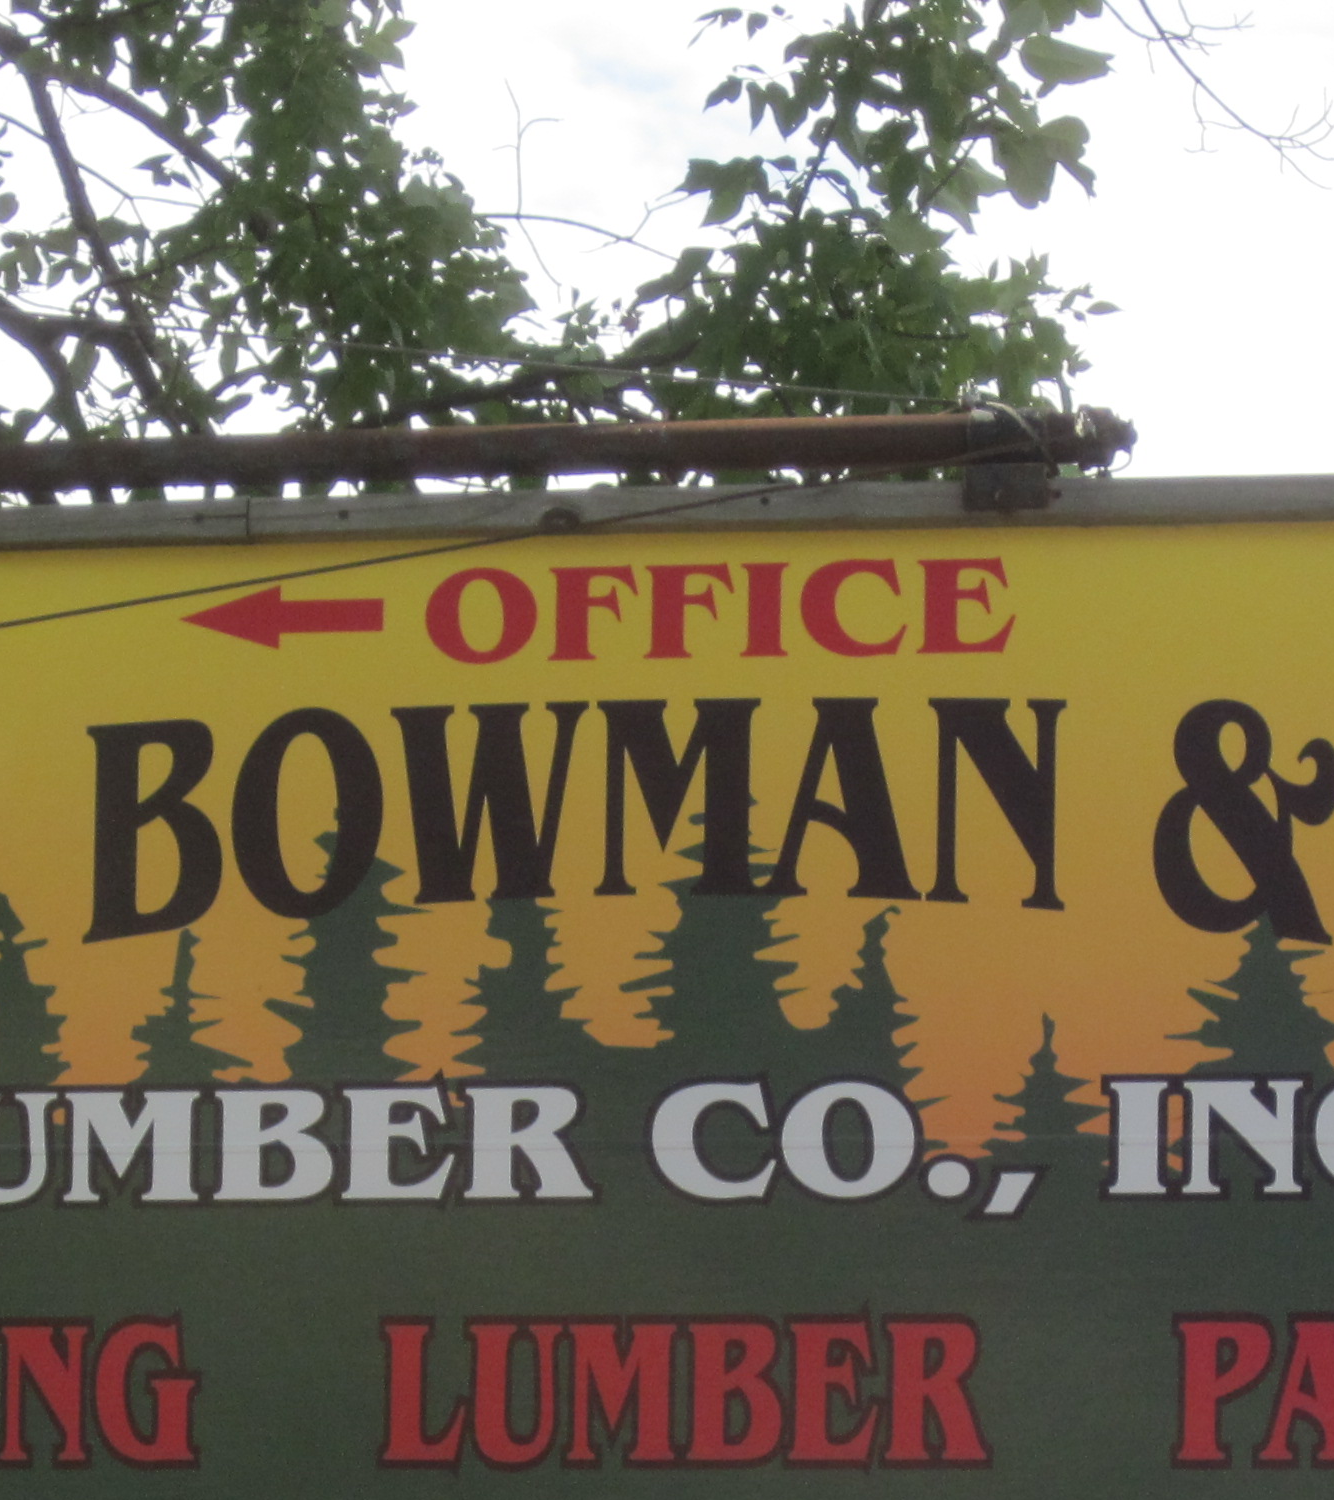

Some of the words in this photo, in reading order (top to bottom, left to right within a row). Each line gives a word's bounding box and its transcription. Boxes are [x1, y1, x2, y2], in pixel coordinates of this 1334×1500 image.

[424, 556, 1017, 665] OFFICE
[82, 697, 1067, 944] BOWMAN
[647, 1074, 1048, 1218] CO.,
[377, 1304, 993, 1474] LUMBER
